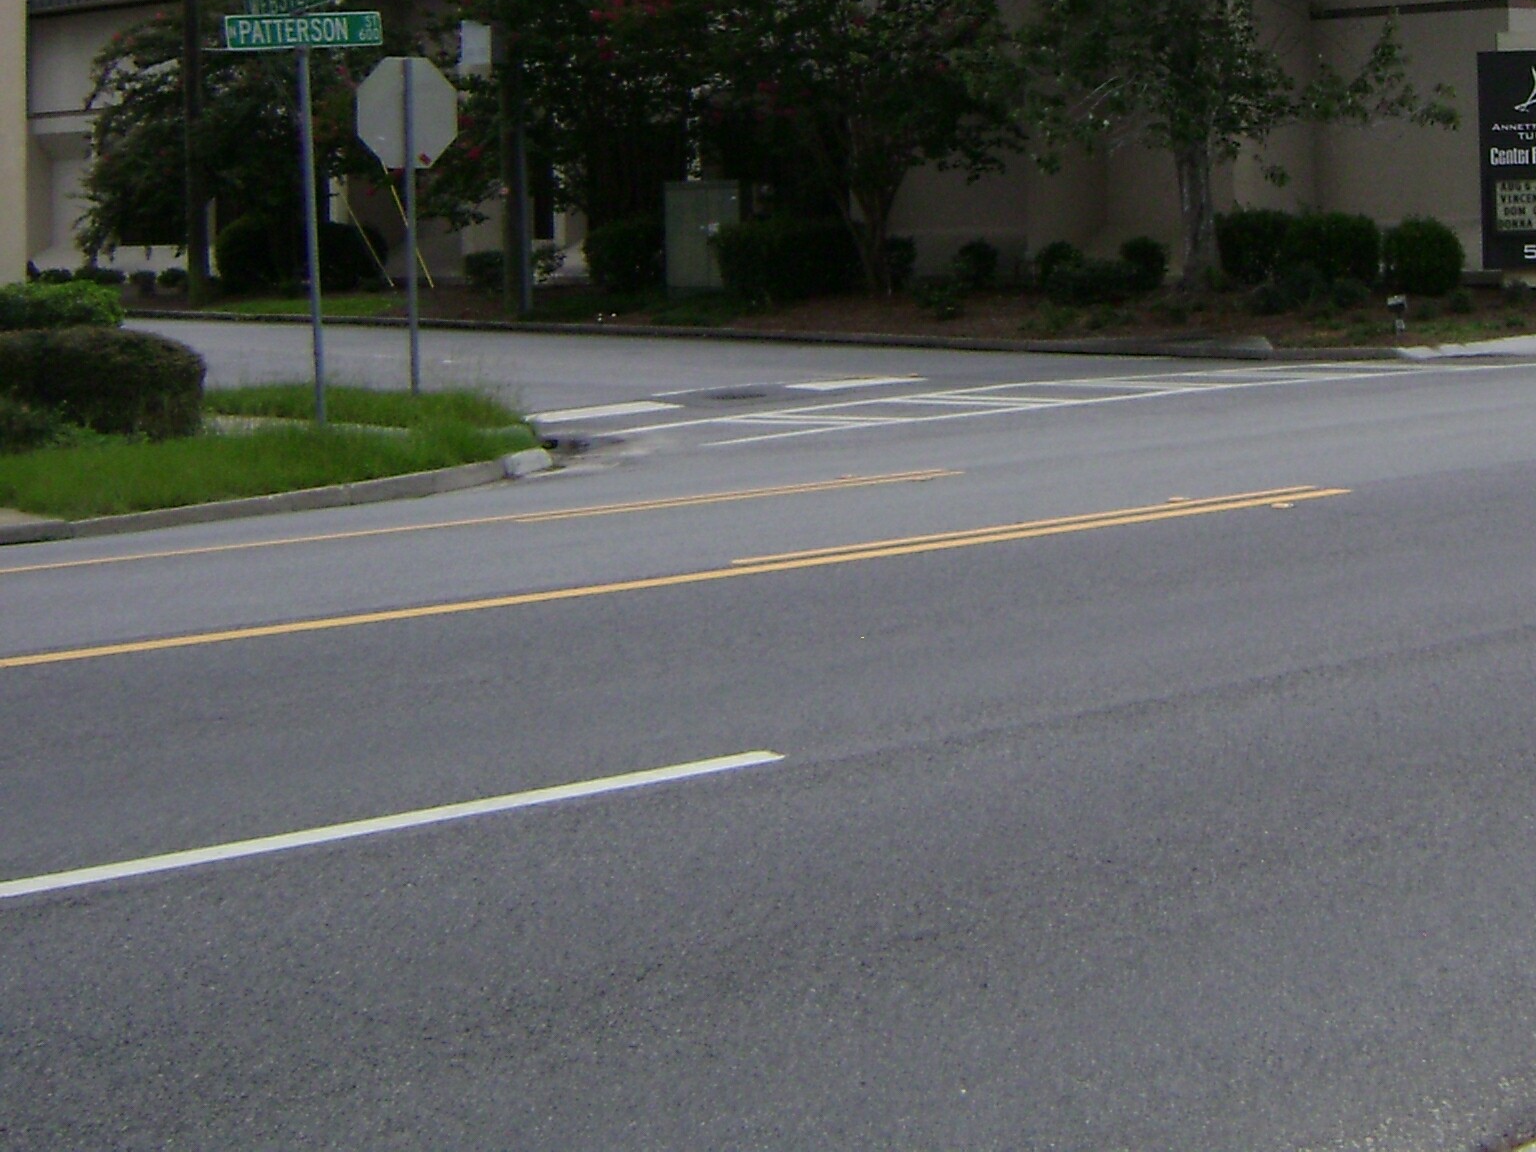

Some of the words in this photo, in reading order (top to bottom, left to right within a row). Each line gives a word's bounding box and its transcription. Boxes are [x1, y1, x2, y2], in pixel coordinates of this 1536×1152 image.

[238, 17, 349, 45] PATTERSON
[364, 15, 377, 28] ST
[1489, 146, 1530, 166] Center
